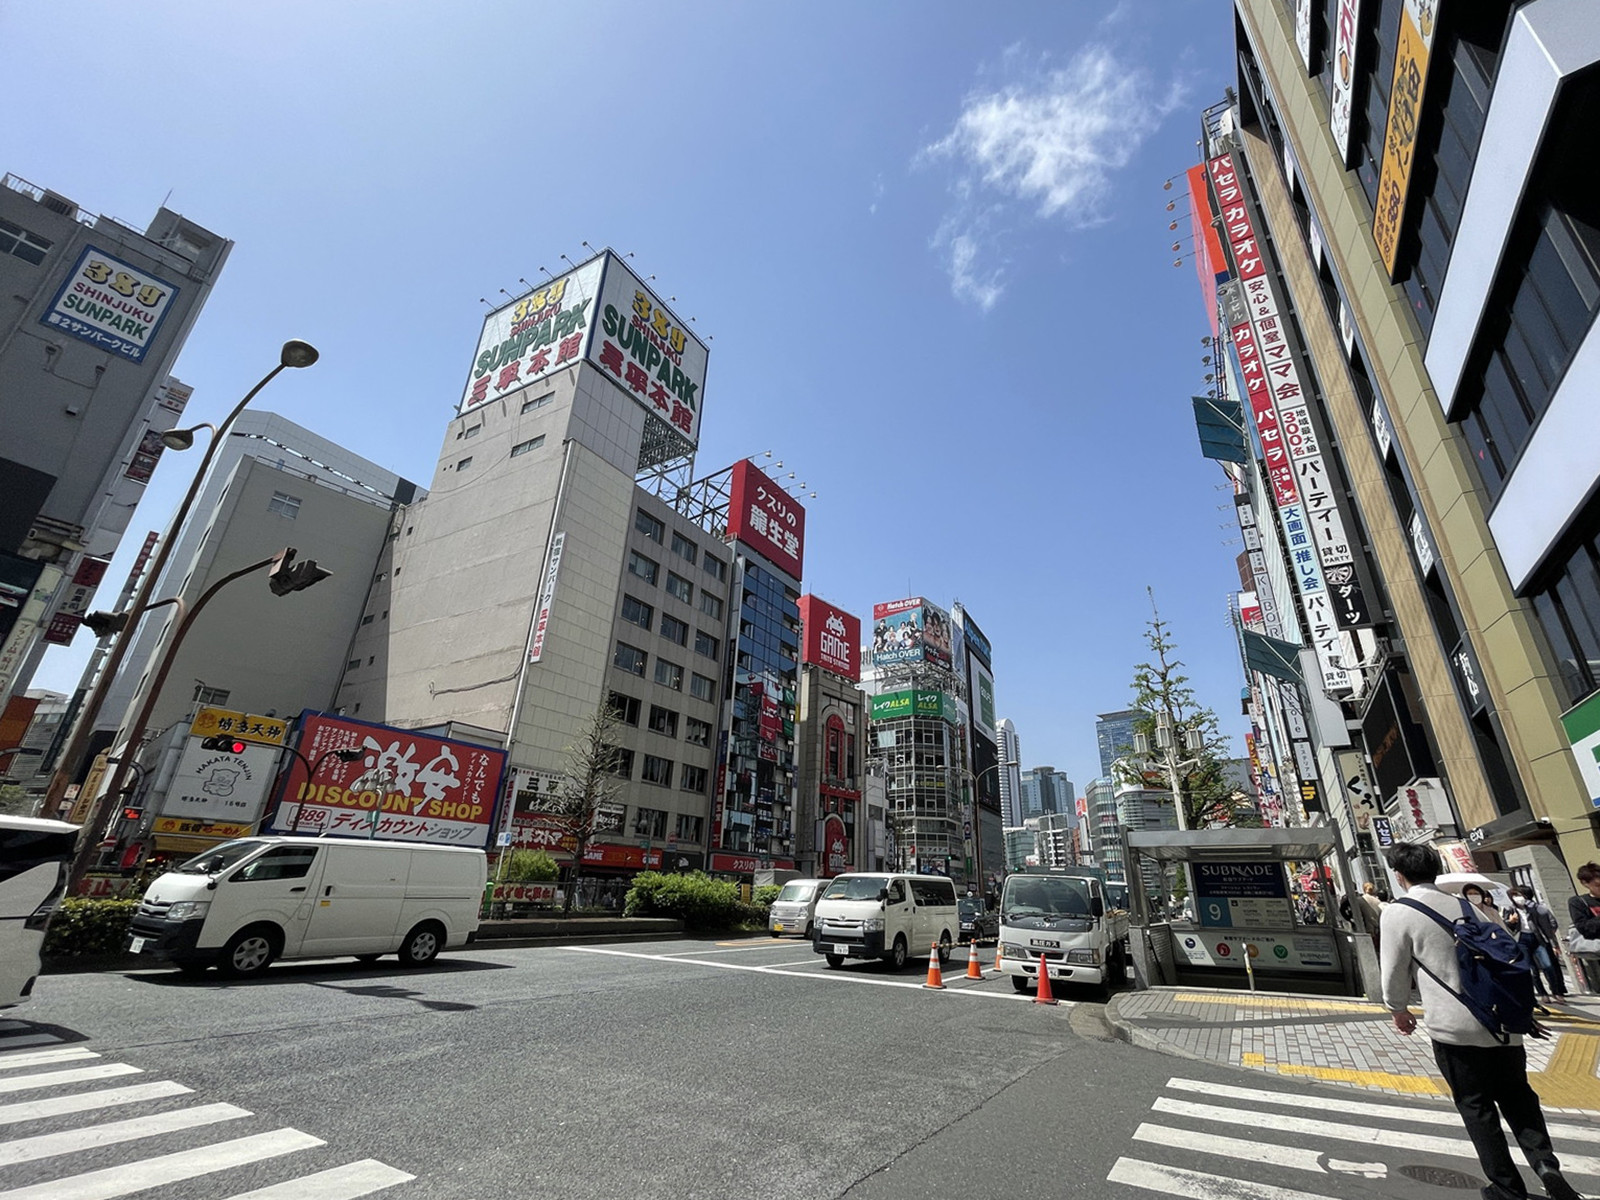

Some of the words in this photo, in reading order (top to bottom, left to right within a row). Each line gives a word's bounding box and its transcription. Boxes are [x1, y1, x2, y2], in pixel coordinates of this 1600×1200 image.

[73, 281, 155, 324] SHINJUKU
[83, 259, 167, 308] 389
[511, 278, 569, 326] 389
[63, 293, 149, 341] SUNPARK
[510, 303, 563, 337] SHINJUKU
[632, 289, 688, 354] 389
[474, 298, 593, 379] SUNPARK
[602, 304, 699, 412] SUNPARK
[631, 314, 682, 366] SHINJUKU
[1235, 327, 1264, 391] カラオケ
[1282, 411, 1306, 456] 300名
[1295, 408, 1318, 453] 地域最大級
[756, 486, 798, 527] クスリの
[1300, 459, 1333, 541] パーティー
[749, 504, 799, 561] 龍生堂
[1322, 545, 1348, 557] 貸切
[1324, 555, 1350, 564] PARTY
[1338, 584, 1361, 624] ダーツ
[820, 631, 850, 663] GAME
[898, 649, 921, 658] OVER
[873, 698, 910, 711] レイクALSA
[917, 693, 937, 702] レイク
[917, 702, 938, 711] ALSA
[218, 717, 281, 739] 博多天神
[196, 755, 231, 774] HAKATA
[233, 757, 252, 781] TENJIN
[349, 735, 461, 816] 激安
[471, 753, 490, 804] なんでも
[297, 782, 422, 812] DISCOUNT
[428, 800, 483, 820] SHOP
[330, 812, 479, 840] ディスカウントショップ
[1376, 820, 1392, 846] パセラ
[1201, 864, 1274, 877] SUBNADE
[1208, 903, 1221, 920] 9
